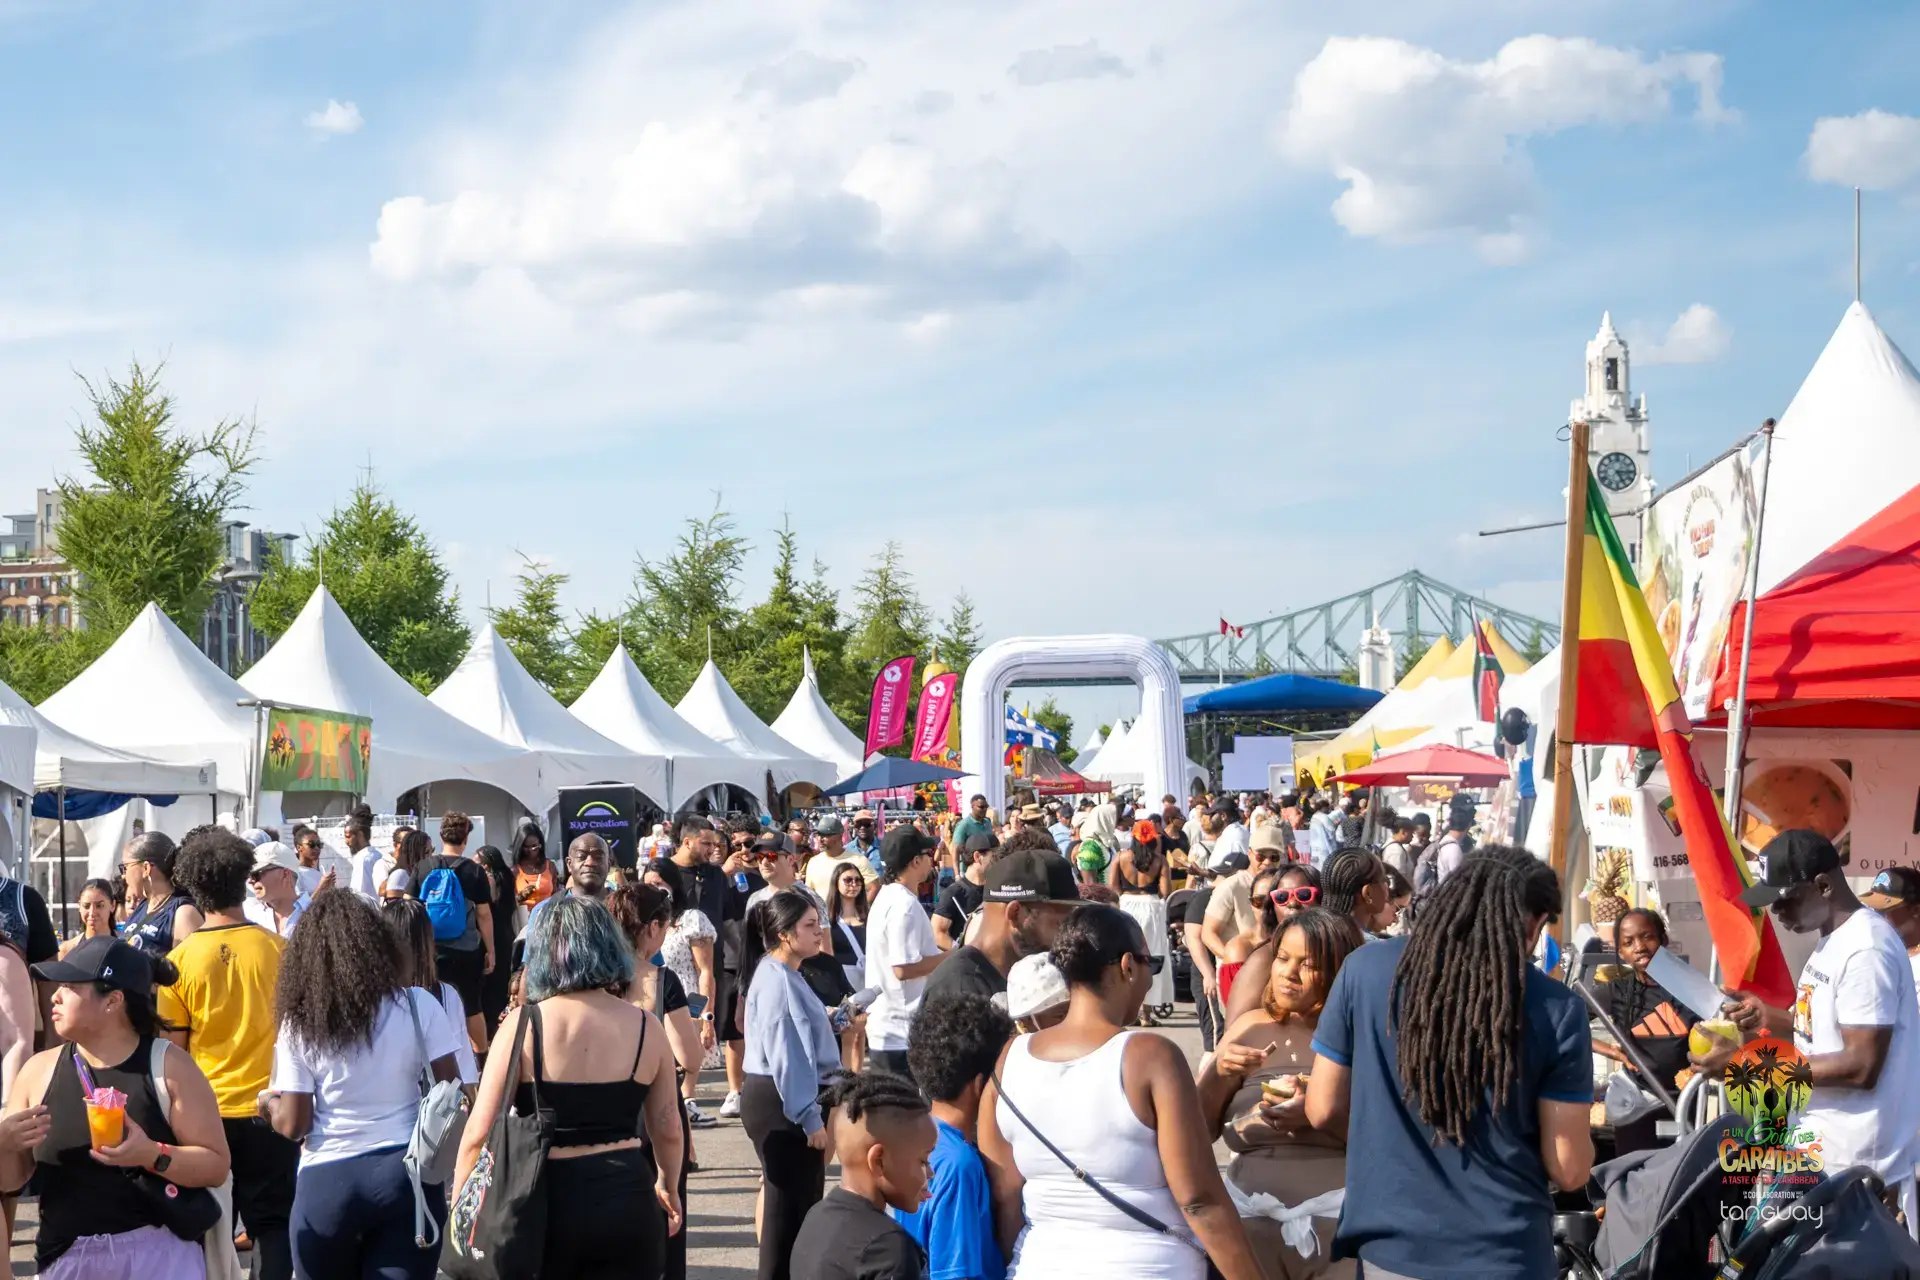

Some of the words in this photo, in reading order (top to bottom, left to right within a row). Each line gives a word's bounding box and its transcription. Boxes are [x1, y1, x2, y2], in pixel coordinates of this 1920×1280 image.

[881, 685, 893, 713] DEPOT
[926, 698, 938, 725] DEPOT
[877, 715, 889, 743] LATIN
